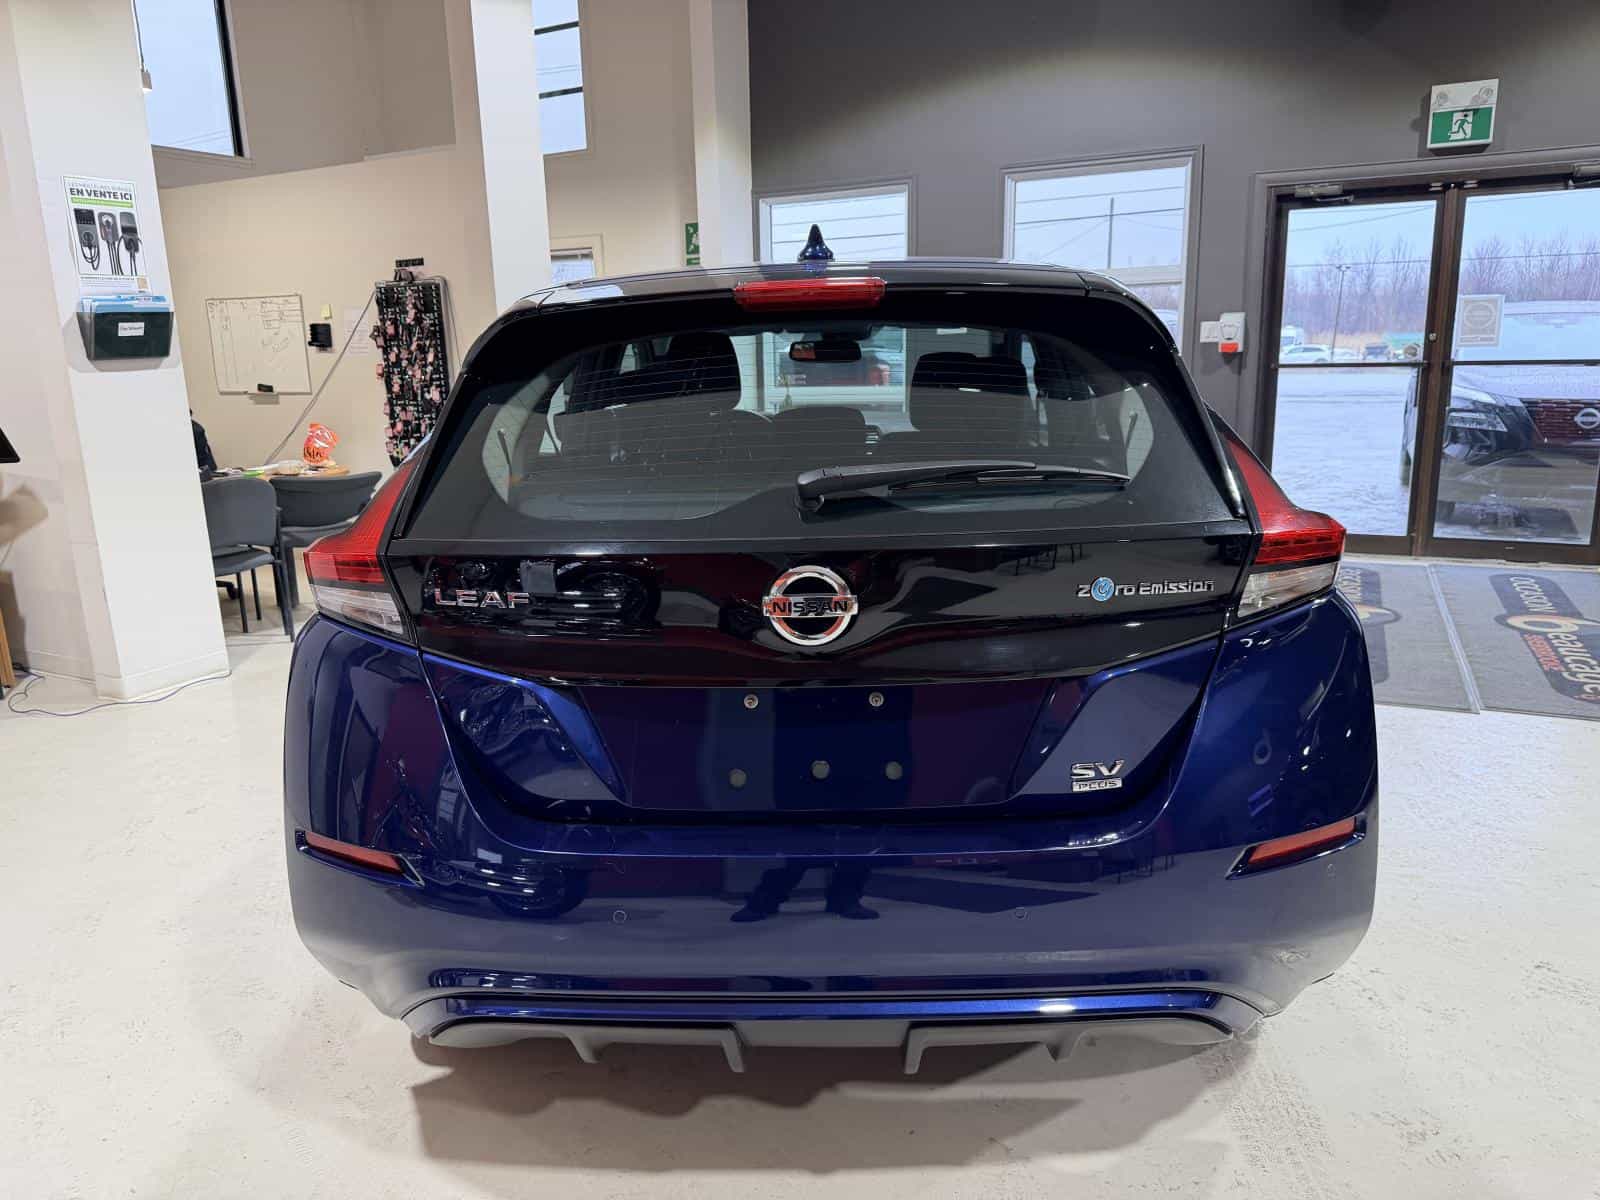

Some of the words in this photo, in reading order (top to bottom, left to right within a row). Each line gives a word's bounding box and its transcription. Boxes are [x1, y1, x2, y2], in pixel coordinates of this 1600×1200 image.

[70, 188, 84, 196] EN
[85, 189, 119, 199] VENTE
[120, 192, 132, 200] ICI
[1139, 579, 1215, 595] Emission
[434, 588, 529, 608] LEAF
[771, 600, 848, 614] NISSAN
[1071, 760, 1124, 778] SV
[1076, 779, 1119, 790] PLUS
